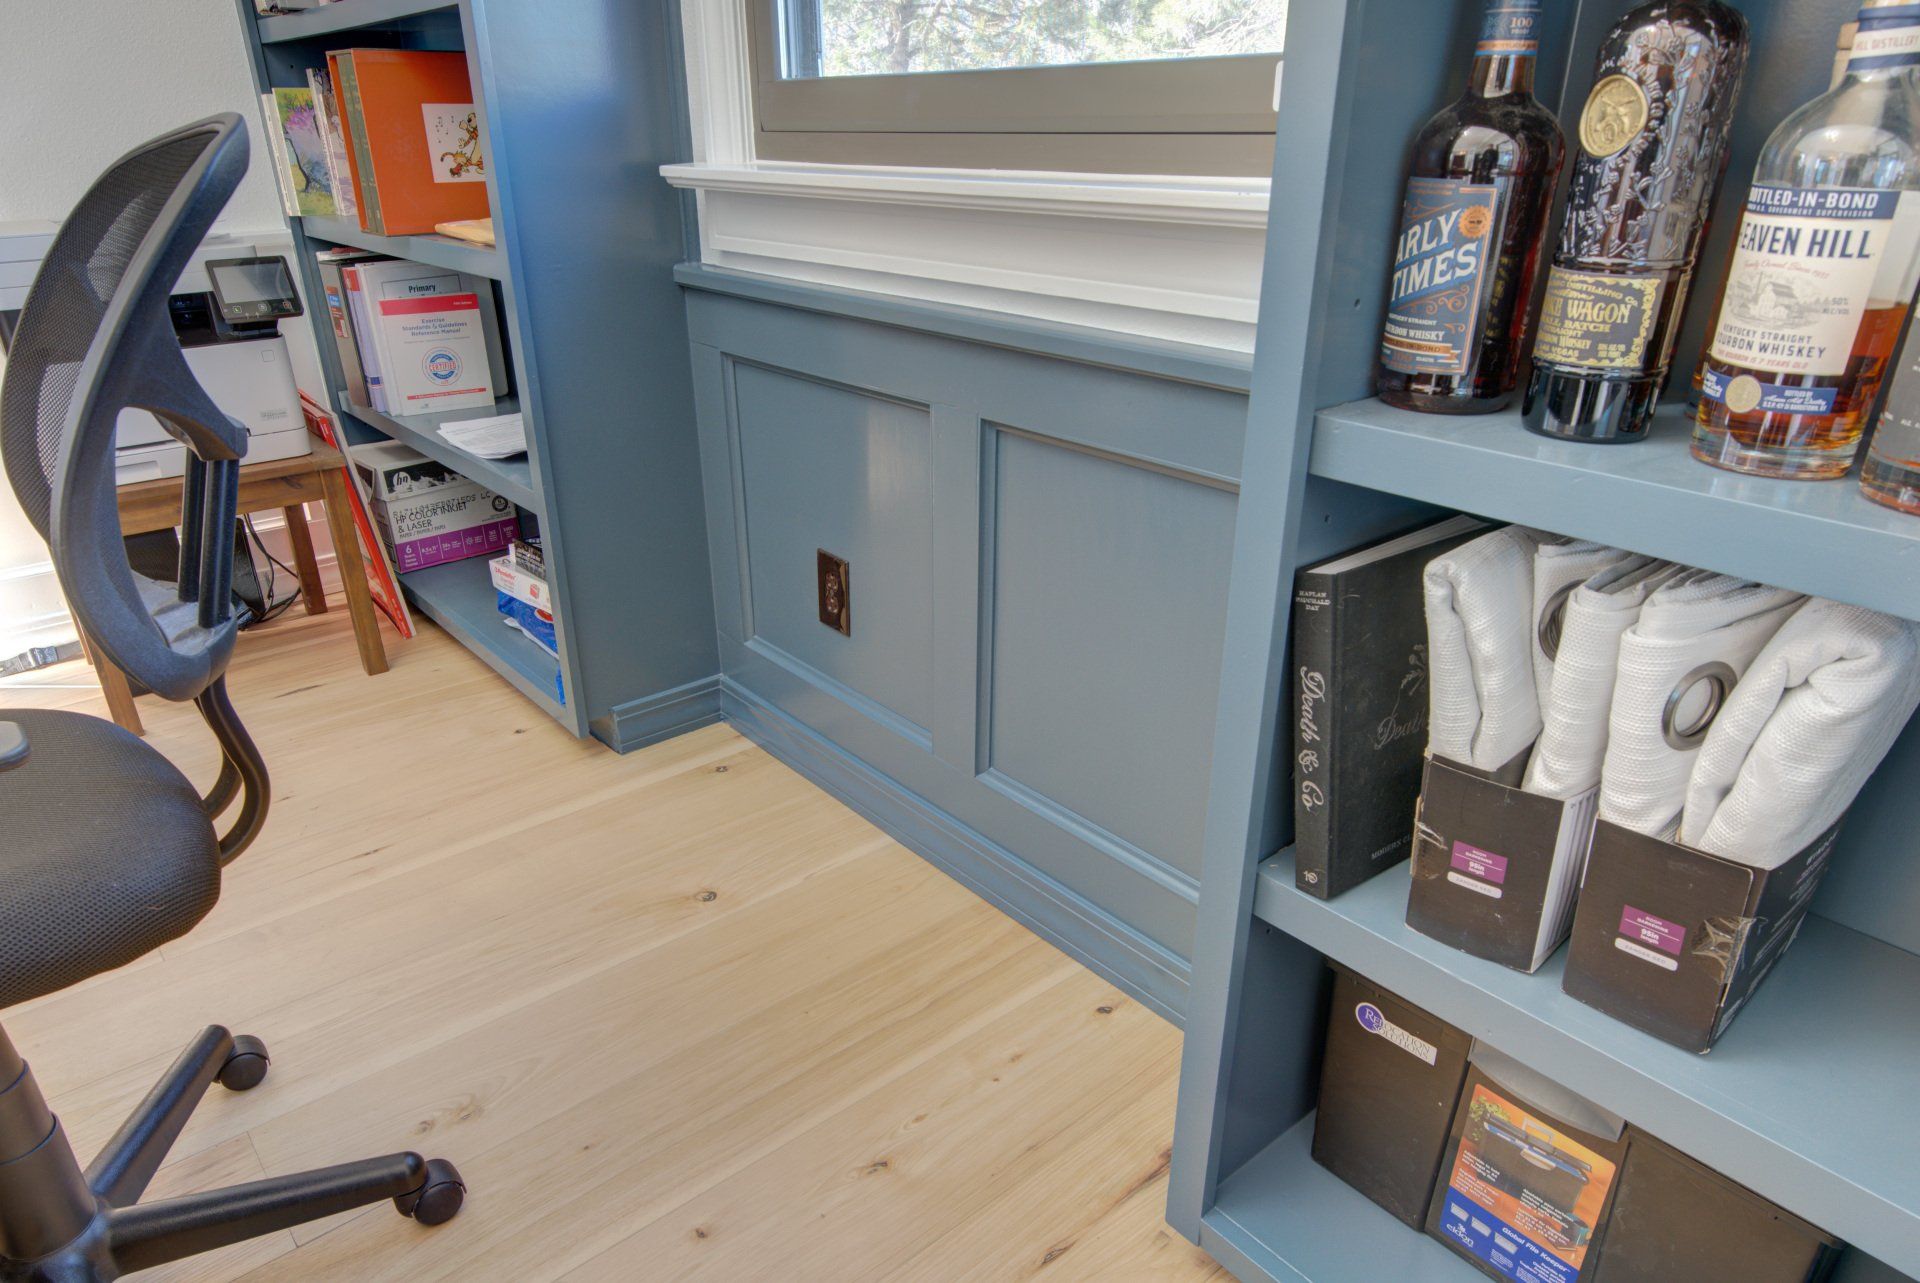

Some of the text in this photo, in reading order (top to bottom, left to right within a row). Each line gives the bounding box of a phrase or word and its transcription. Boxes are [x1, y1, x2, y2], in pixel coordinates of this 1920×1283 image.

[1510, 16, 1533, 28] 100
[1816, 208, 1874, 217] SUPERVISION
[1395, 208, 1462, 268] ARLY
[1741, 222, 1871, 258] EAVEN HILL
[1391, 241, 1479, 301] TIMES
[408, 284, 436, 293] Primary
[1567, 299, 1632, 324] WAGON
[1409, 329, 1445, 341] WHISKY
[1564, 319, 1611, 333] BATCH
[1760, 331, 1812, 344] STRAIGHT
[1717, 332, 1826, 359] OURBON WHISKEY
[429, 361, 457, 372] CERTIFIED
[395, 501, 467, 525] HP COLOR INKJET
[398, 519, 432, 533] & LASER
[405, 545, 412, 554] 6
[1299, 590, 1328, 598] KAPLAN
[1300, 666, 1325, 743] Death
[1301, 780, 1325, 812] Co
[1371, 838, 1402, 860] MODERN
[1364, 1007, 1430, 1053] RELOCATION
[1372, 1022, 1430, 1061] SOLUTIONS
[1447, 1223, 1474, 1246] eldon
[1501, 1225, 1525, 1245] Global
[1525, 1241, 1539, 1255] File
[1539, 1251, 1567, 1273] Keeper
